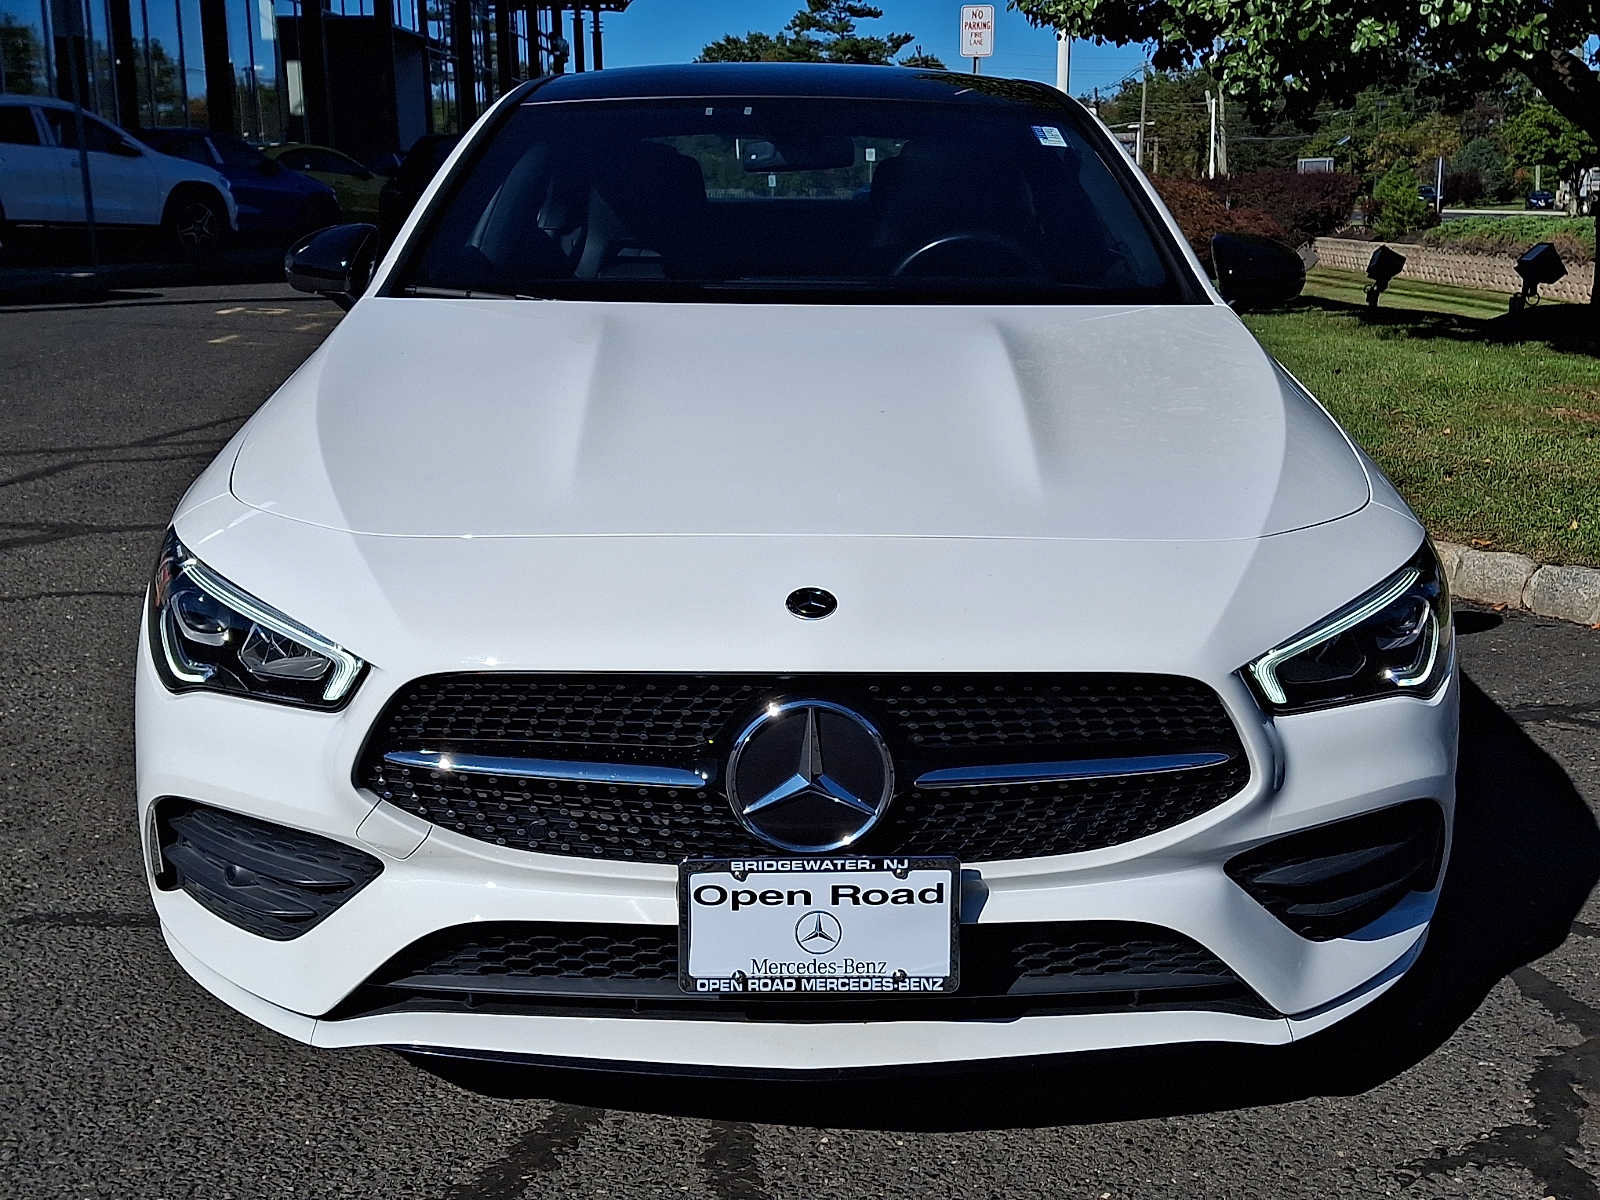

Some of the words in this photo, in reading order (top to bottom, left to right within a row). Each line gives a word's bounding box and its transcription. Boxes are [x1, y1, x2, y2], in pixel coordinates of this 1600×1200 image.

[972, 10, 983, 19] NO
[964, 21, 991, 30] PARKING
[970, 31, 983, 39] FIRE
[883, 858, 909, 869] NJ
[693, 884, 812, 911] Open
[831, 882, 944, 906] Road
[750, 957, 887, 975] Mercedes-Benz
[696, 979, 743, 992] OPEN
[747, 979, 796, 991] ROAD
